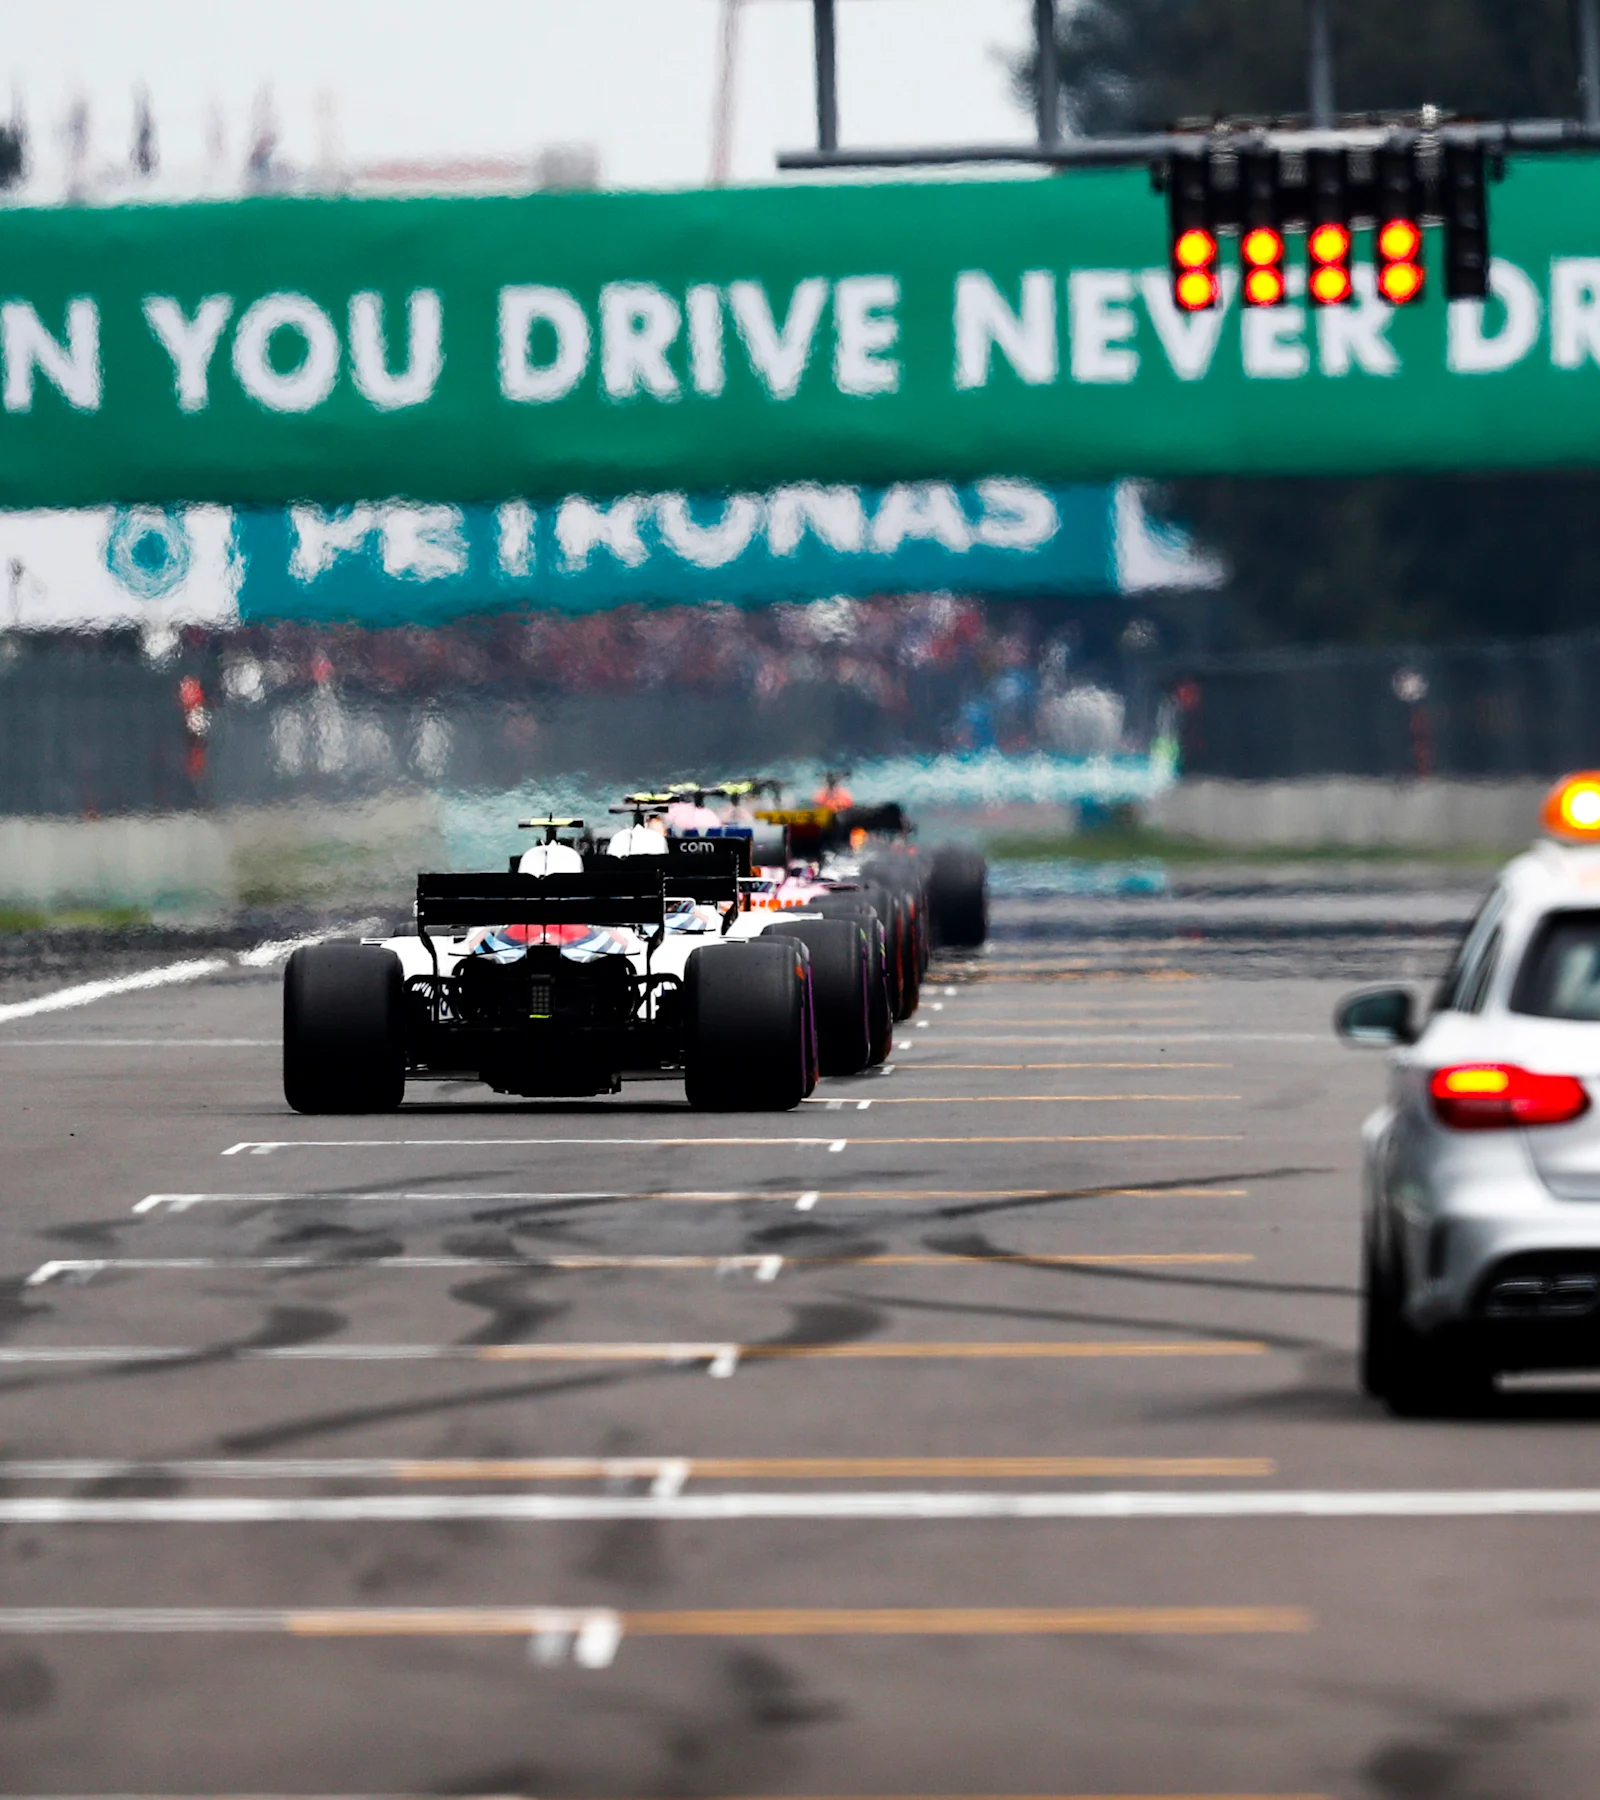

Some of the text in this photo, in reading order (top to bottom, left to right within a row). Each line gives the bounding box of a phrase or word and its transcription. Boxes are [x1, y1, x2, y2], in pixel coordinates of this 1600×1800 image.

[142, 288, 444, 414] YOU
[498, 274, 900, 402] DRIVE
[953, 267, 1400, 391] NEVER
